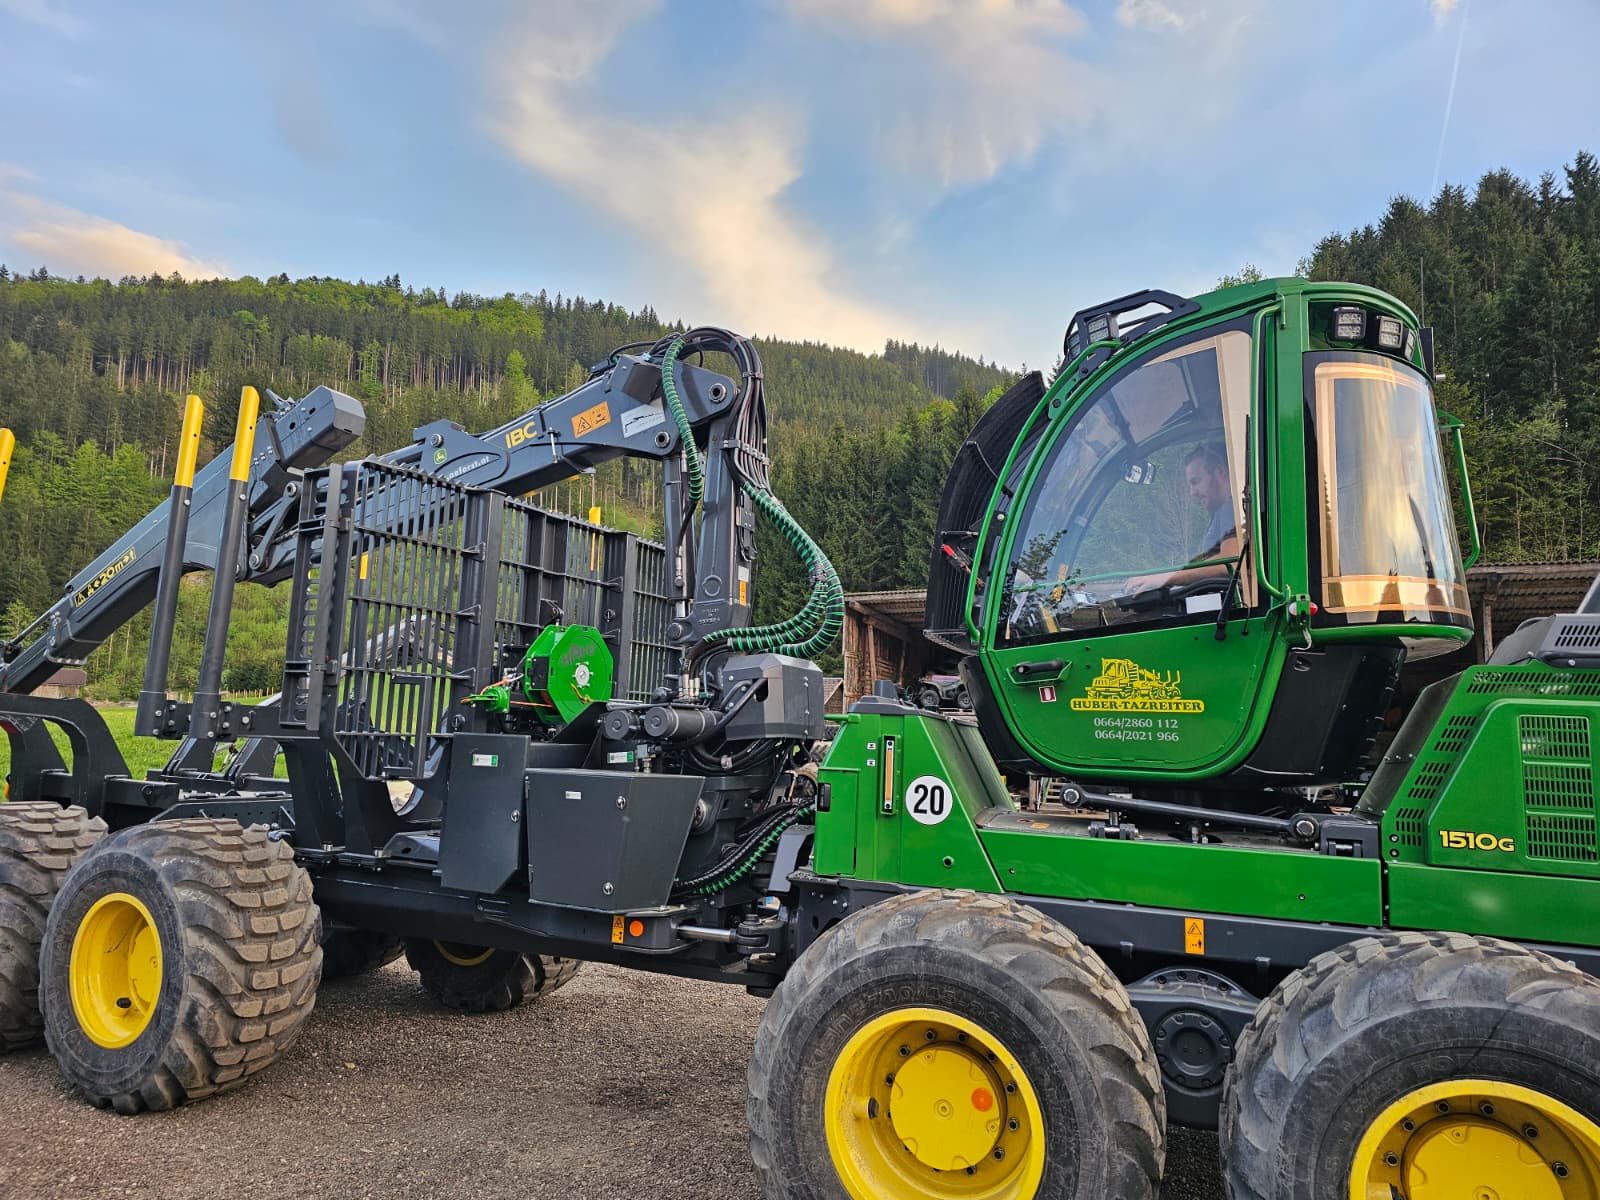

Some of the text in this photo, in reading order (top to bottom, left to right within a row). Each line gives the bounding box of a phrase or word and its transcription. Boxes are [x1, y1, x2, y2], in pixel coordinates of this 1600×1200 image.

[505, 421, 537, 449] IBC
[1072, 700, 1203, 711] HUBER-TAZREITER
[1093, 717, 1179, 729] 0664/2860 112
[1095, 730, 1179, 742] 0664/2021 966
[913, 784, 945, 815] 20
[1439, 830, 1515, 852] 1510G
